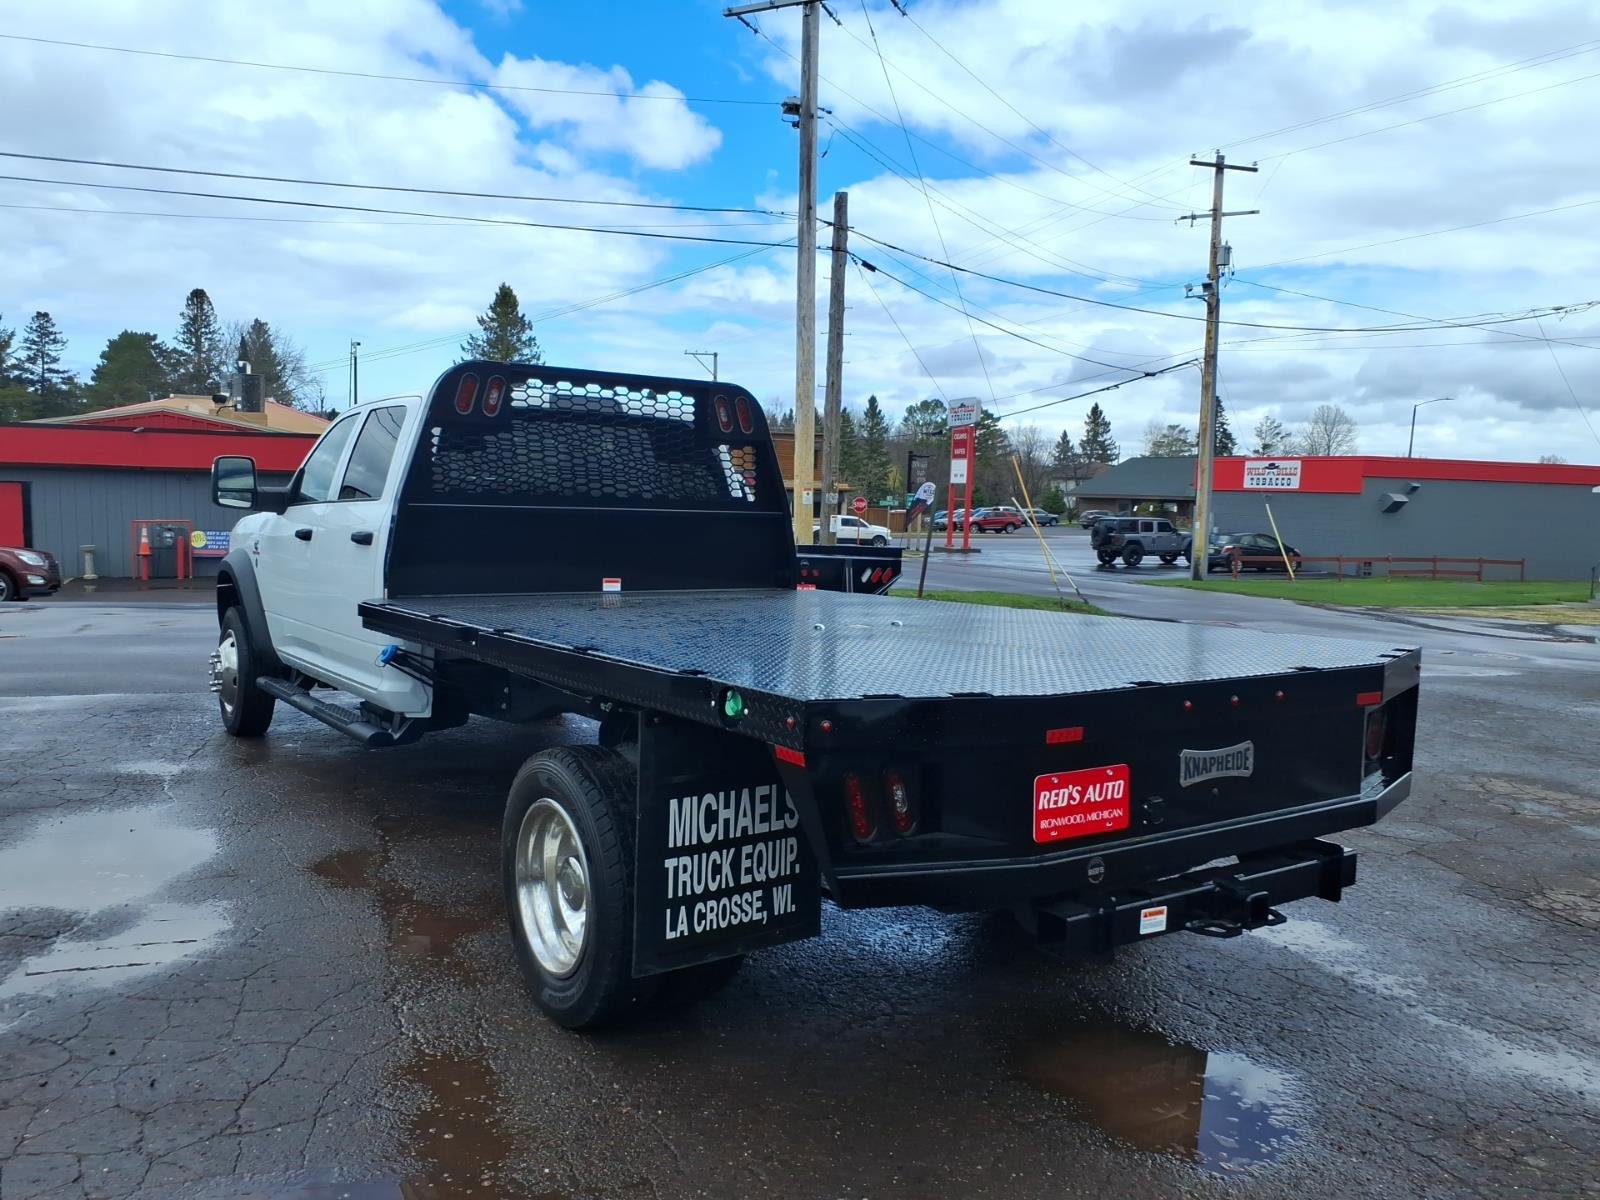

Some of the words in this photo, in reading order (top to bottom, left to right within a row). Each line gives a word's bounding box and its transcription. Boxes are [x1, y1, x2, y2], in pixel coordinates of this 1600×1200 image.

[1247, 467, 1266, 476] WILD
[1250, 477, 1292, 486] TOBACCO
[1183, 747, 1250, 781] KNAPHEIDE
[1038, 785, 1082, 810] RED'S
[1083, 780, 1125, 804] AUTO
[668, 784, 800, 848] MICHAELS
[1040, 813, 1086, 829] IRONWOOD,
[1087, 808, 1123, 822] MICHIGAN
[664, 847, 736, 899] TRUCK
[740, 836, 800, 885] EQUIP.
[665, 905, 689, 940] LA
[693, 889, 768, 934] CROSSE,
[773, 883, 796, 916] WI.
